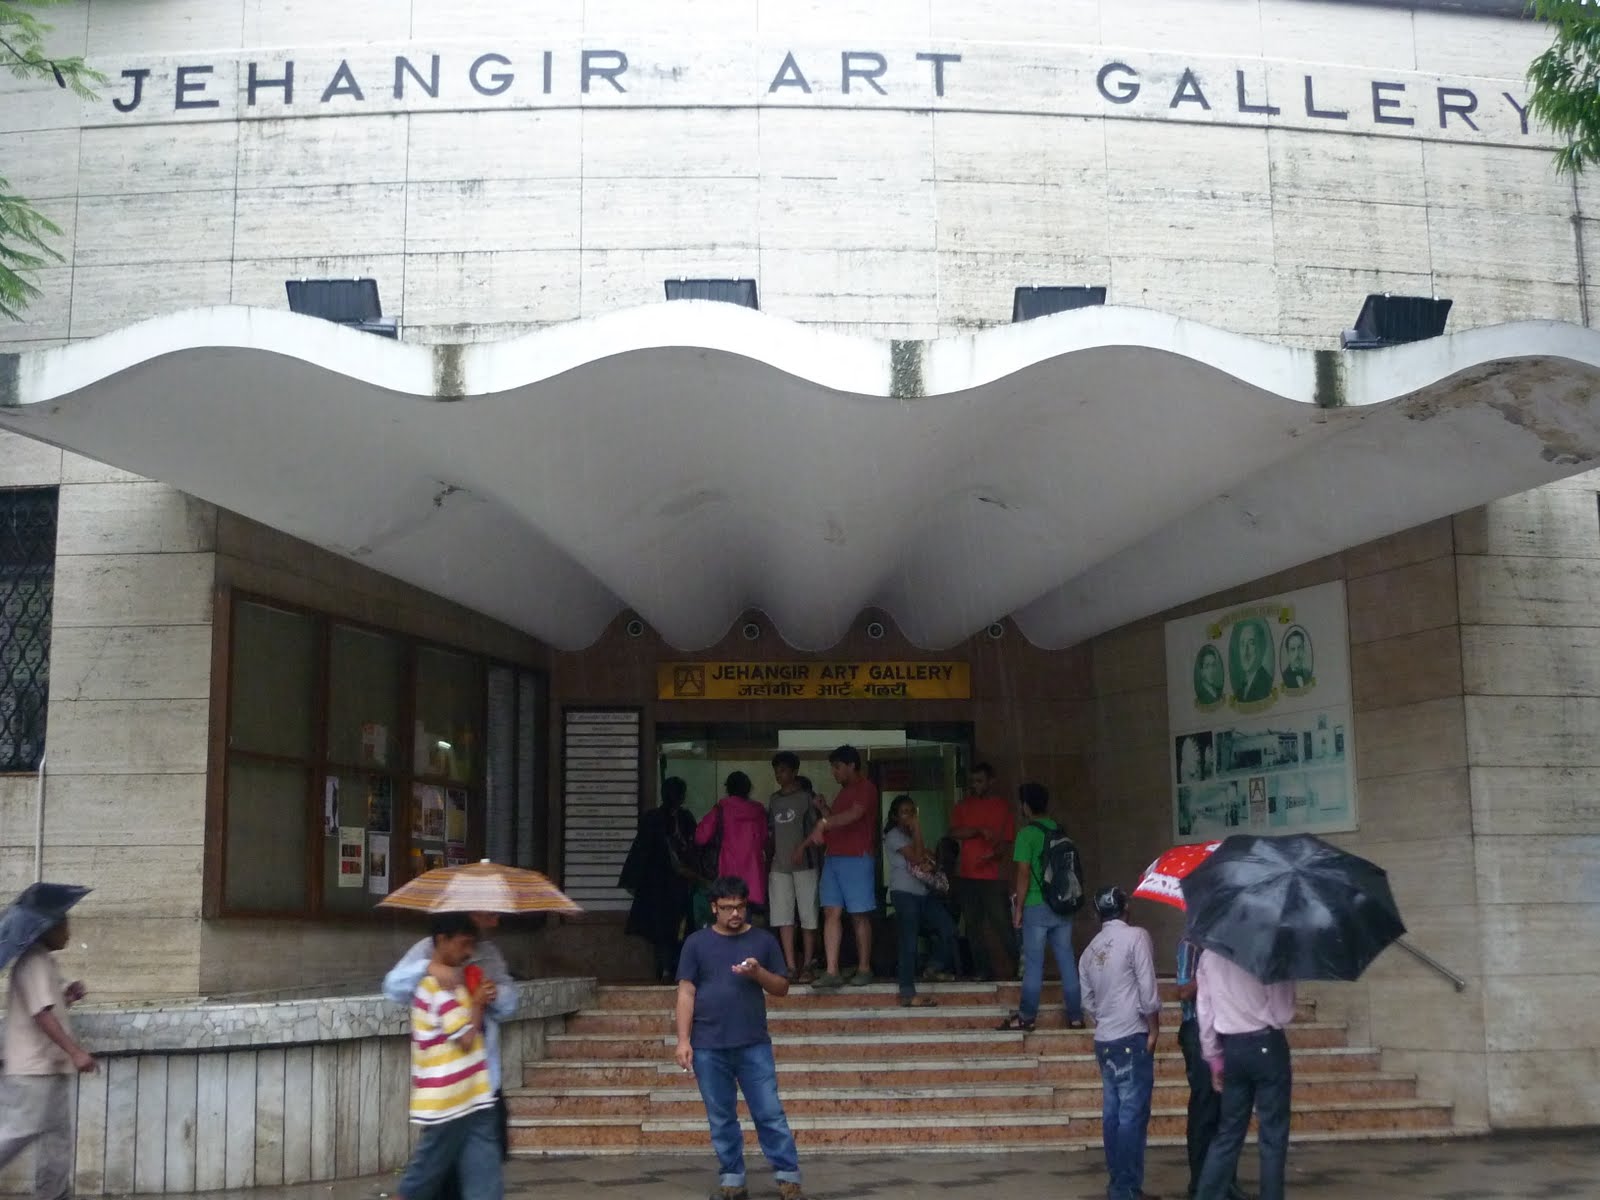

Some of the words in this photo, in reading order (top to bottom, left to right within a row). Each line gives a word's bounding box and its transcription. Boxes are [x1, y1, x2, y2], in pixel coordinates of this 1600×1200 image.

[112, 50, 629, 113] JEHANGIR
[768, 52, 961, 97] ART
[1096, 62, 1530, 136] GALLERY
[712, 665, 810, 680] JEHANGIR
[820, 665, 860, 680] ART
[869, 665, 953, 680] GALLERY
